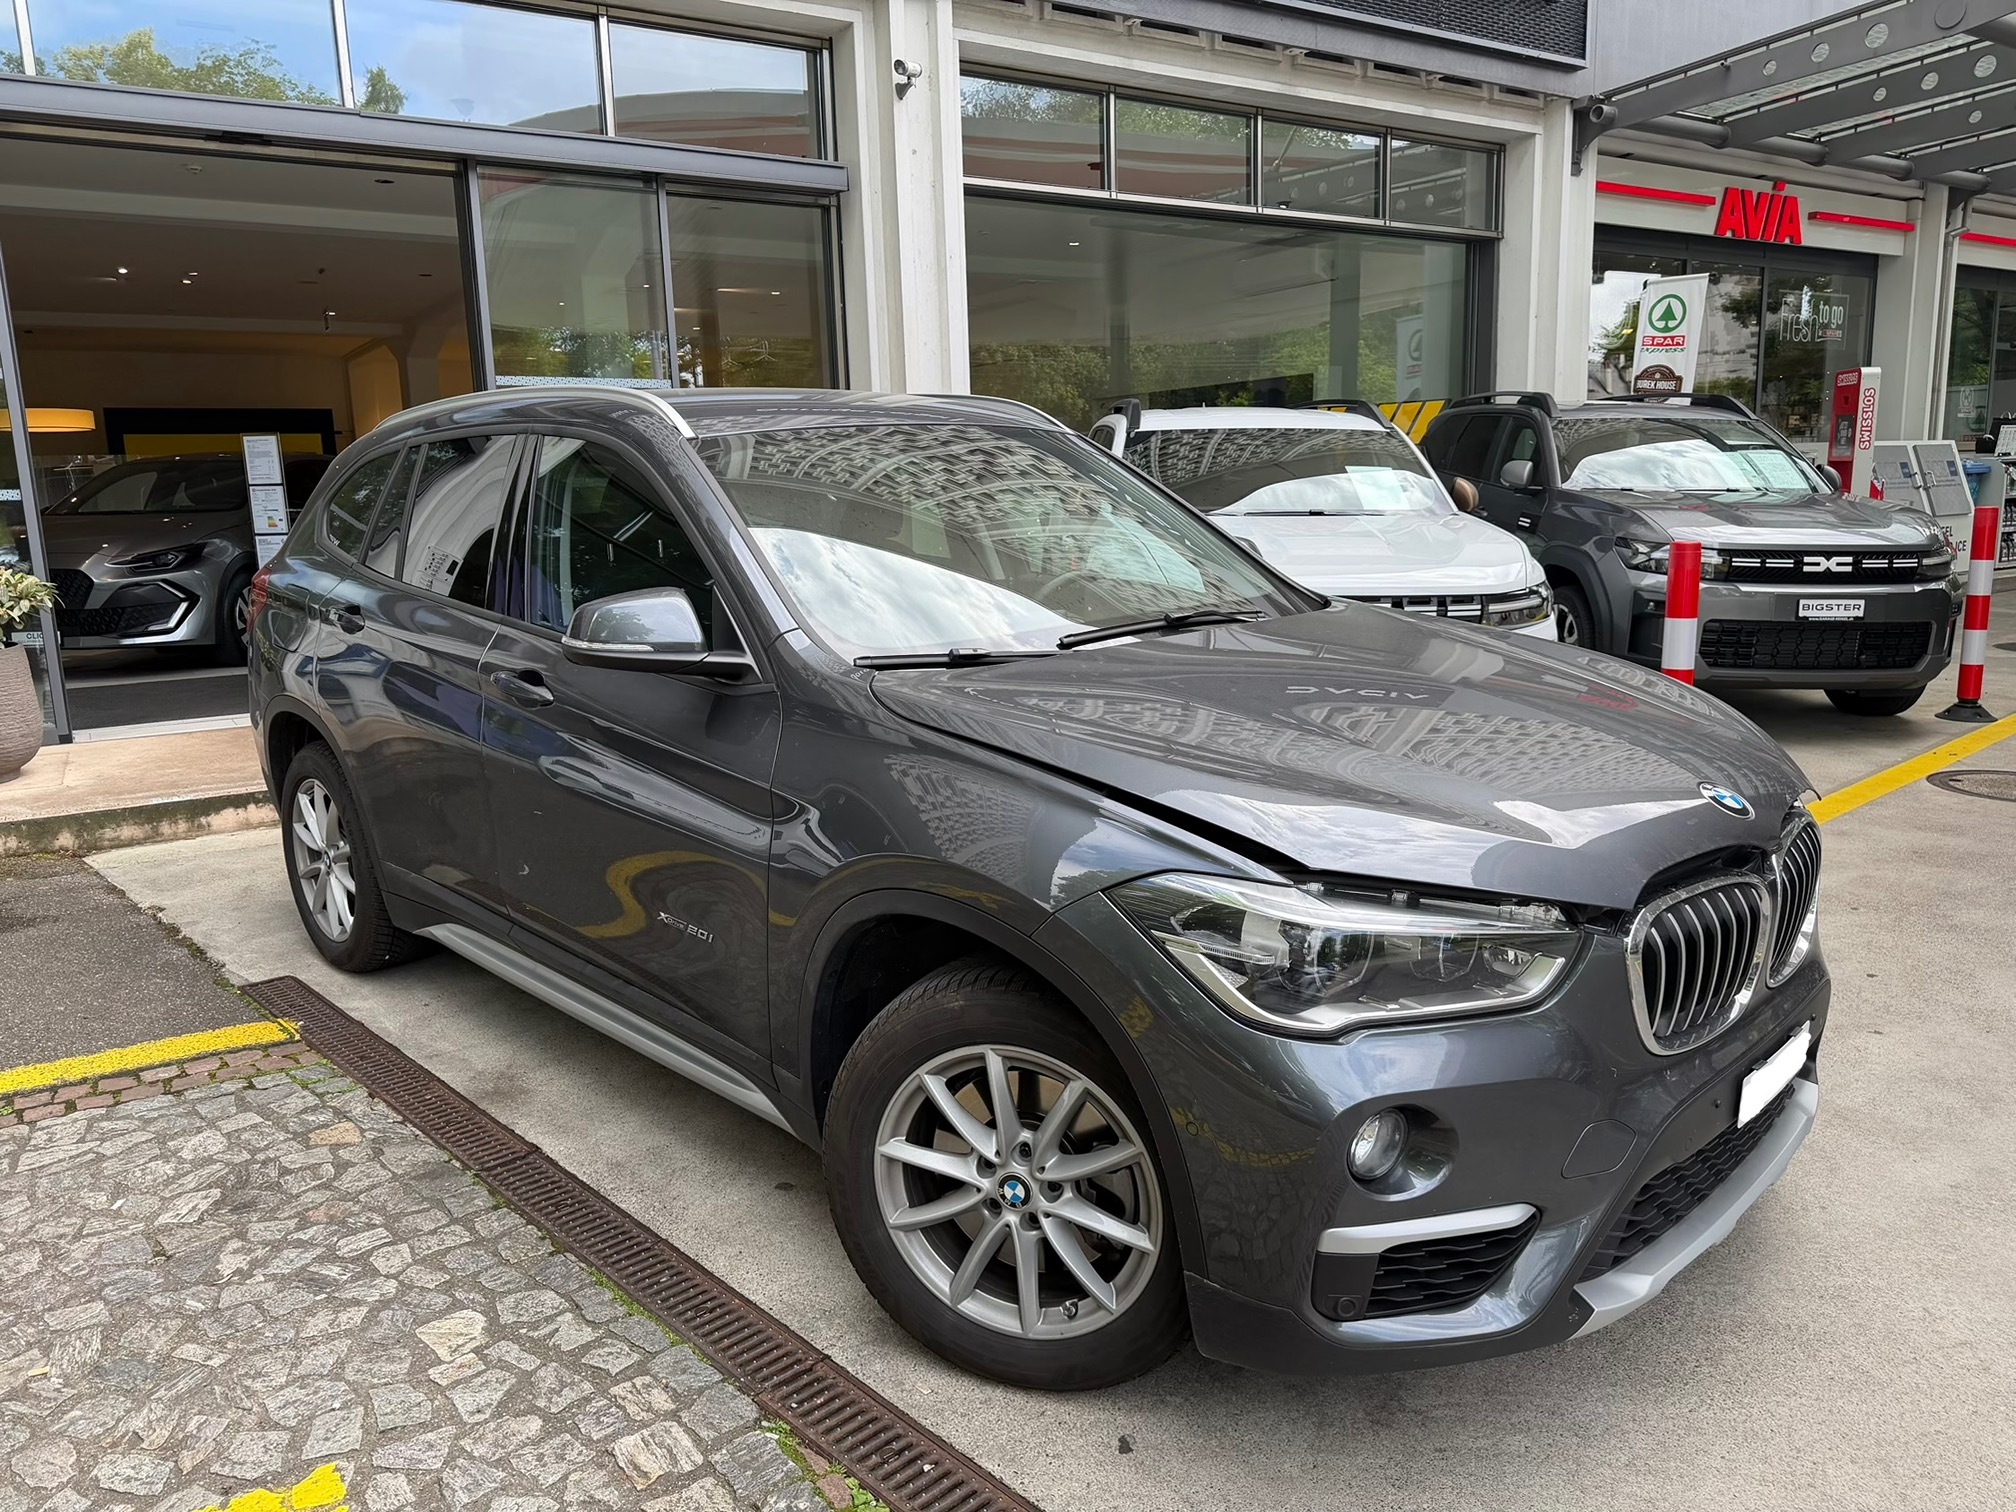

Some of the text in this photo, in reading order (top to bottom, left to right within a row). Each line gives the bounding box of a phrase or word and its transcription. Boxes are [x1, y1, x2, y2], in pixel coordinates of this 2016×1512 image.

[1714, 180, 1802, 245] AVIA
[1819, 301, 1829, 323] to
[1831, 305, 1843, 328] go
[1643, 336, 1684, 346] SPAR
[1859, 387, 1876, 450] SWISSLOS
[1802, 603, 1862, 611] BIGSTER
